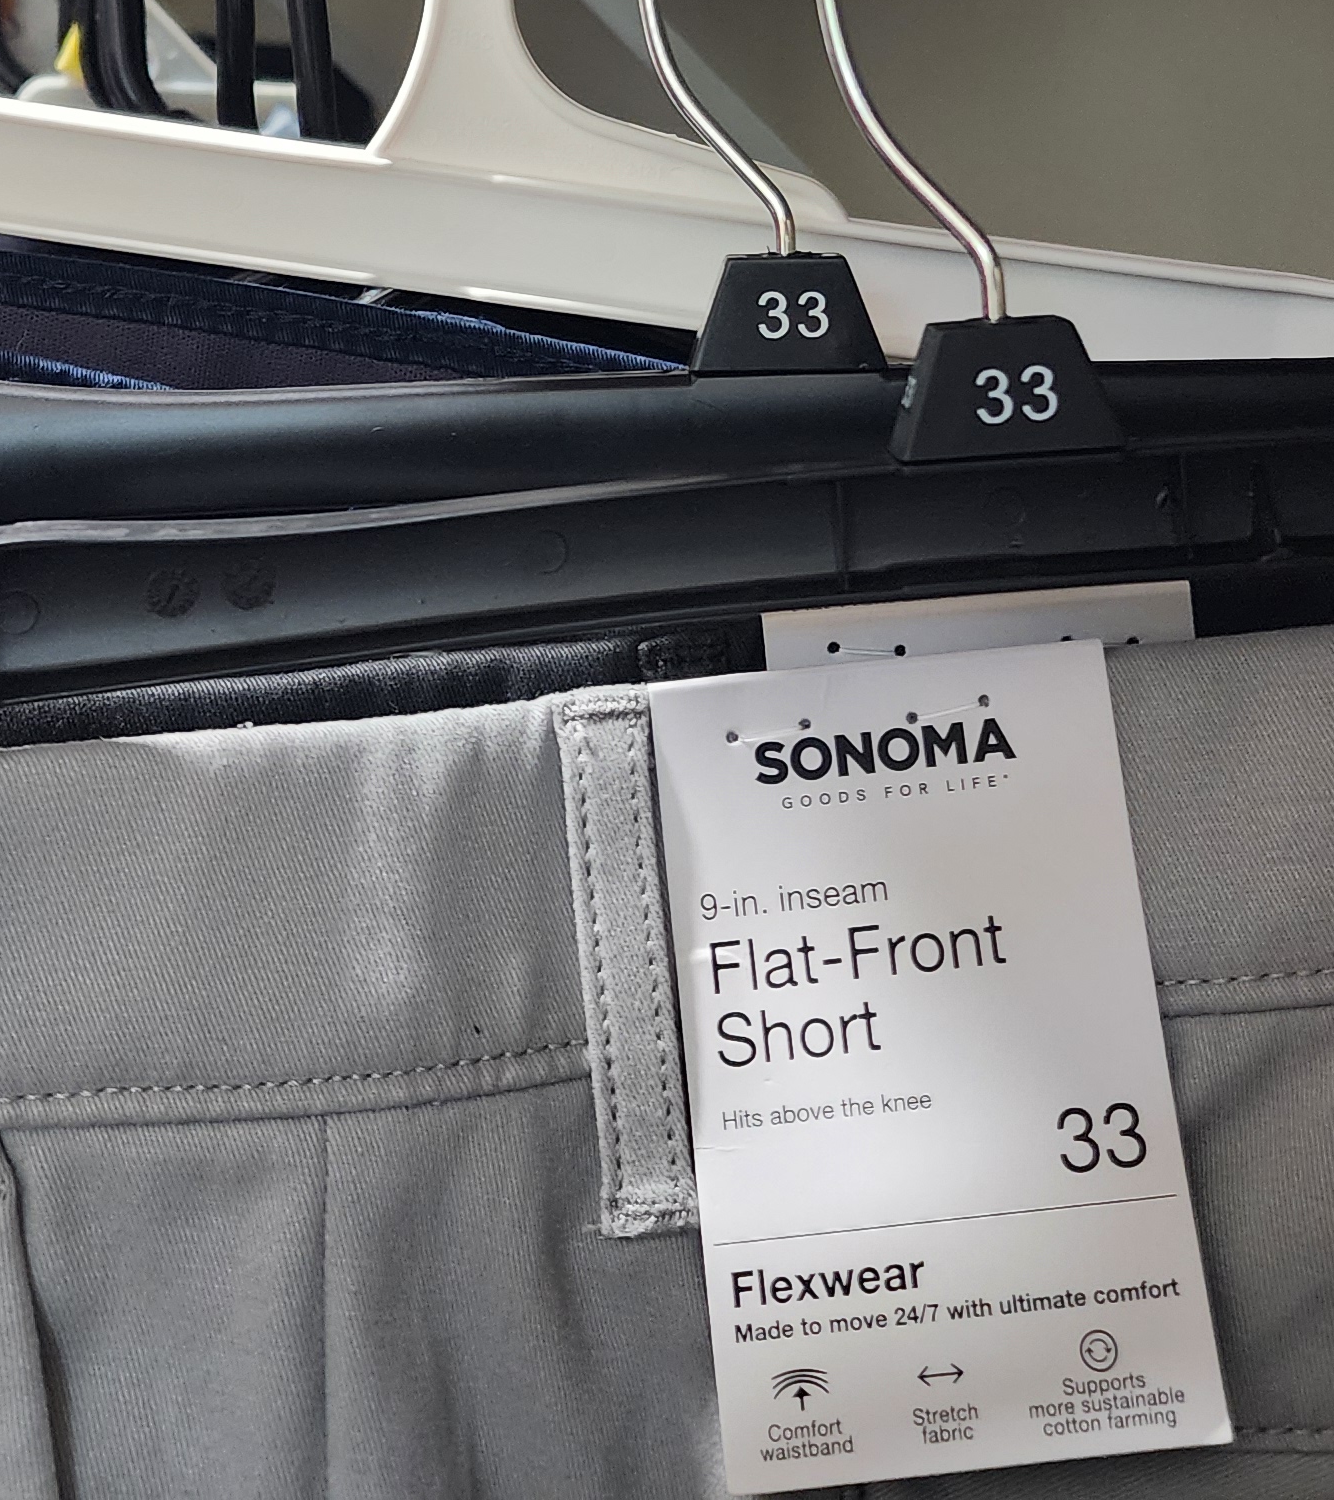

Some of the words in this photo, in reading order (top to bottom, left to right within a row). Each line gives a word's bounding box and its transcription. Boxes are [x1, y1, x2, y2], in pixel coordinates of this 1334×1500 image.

[757, 290, 829, 339] 33
[975, 364, 1059, 425] 33
[754, 717, 1017, 785] SONOMA
[781, 786, 868, 809] GOODS
[884, 781, 930, 799] FOR
[699, 889, 768, 921] 9-in.
[778, 877, 889, 912] inseam
[708, 914, 1008, 995] Flat-Front
[716, 1000, 882, 1068] Short
[722, 1108, 763, 1131] Hits
[770, 1103, 835, 1127] above
[841, 1095, 875, 1118] the
[880, 1091, 933, 1115] knee
[1055, 1101, 1149, 1174] 33
[730, 1259, 926, 1308] Flexwear
[735, 1319, 794, 1343] Made
[801, 1315, 822, 1336] to
[829, 1312, 888, 1333] move
[894, 1303, 939, 1327] 24/7
[946, 1297, 993, 1322] with
[999, 1288, 1087, 1316] ultimate
[1093, 1278, 1181, 1307] comfort
[1028, 1400, 1075, 1419] more
[1081, 1387, 1186, 1414] sustainable
[1062, 1372, 1146, 1399] Supports
[768, 1418, 843, 1443] Comfort
[912, 1403, 979, 1427] Stretch
[921, 1423, 974, 1444] fabric
[1043, 1416, 1101, 1437] cotton
[1107, 1408, 1177, 1432] farming
[760, 1435, 854, 1463] waistband
